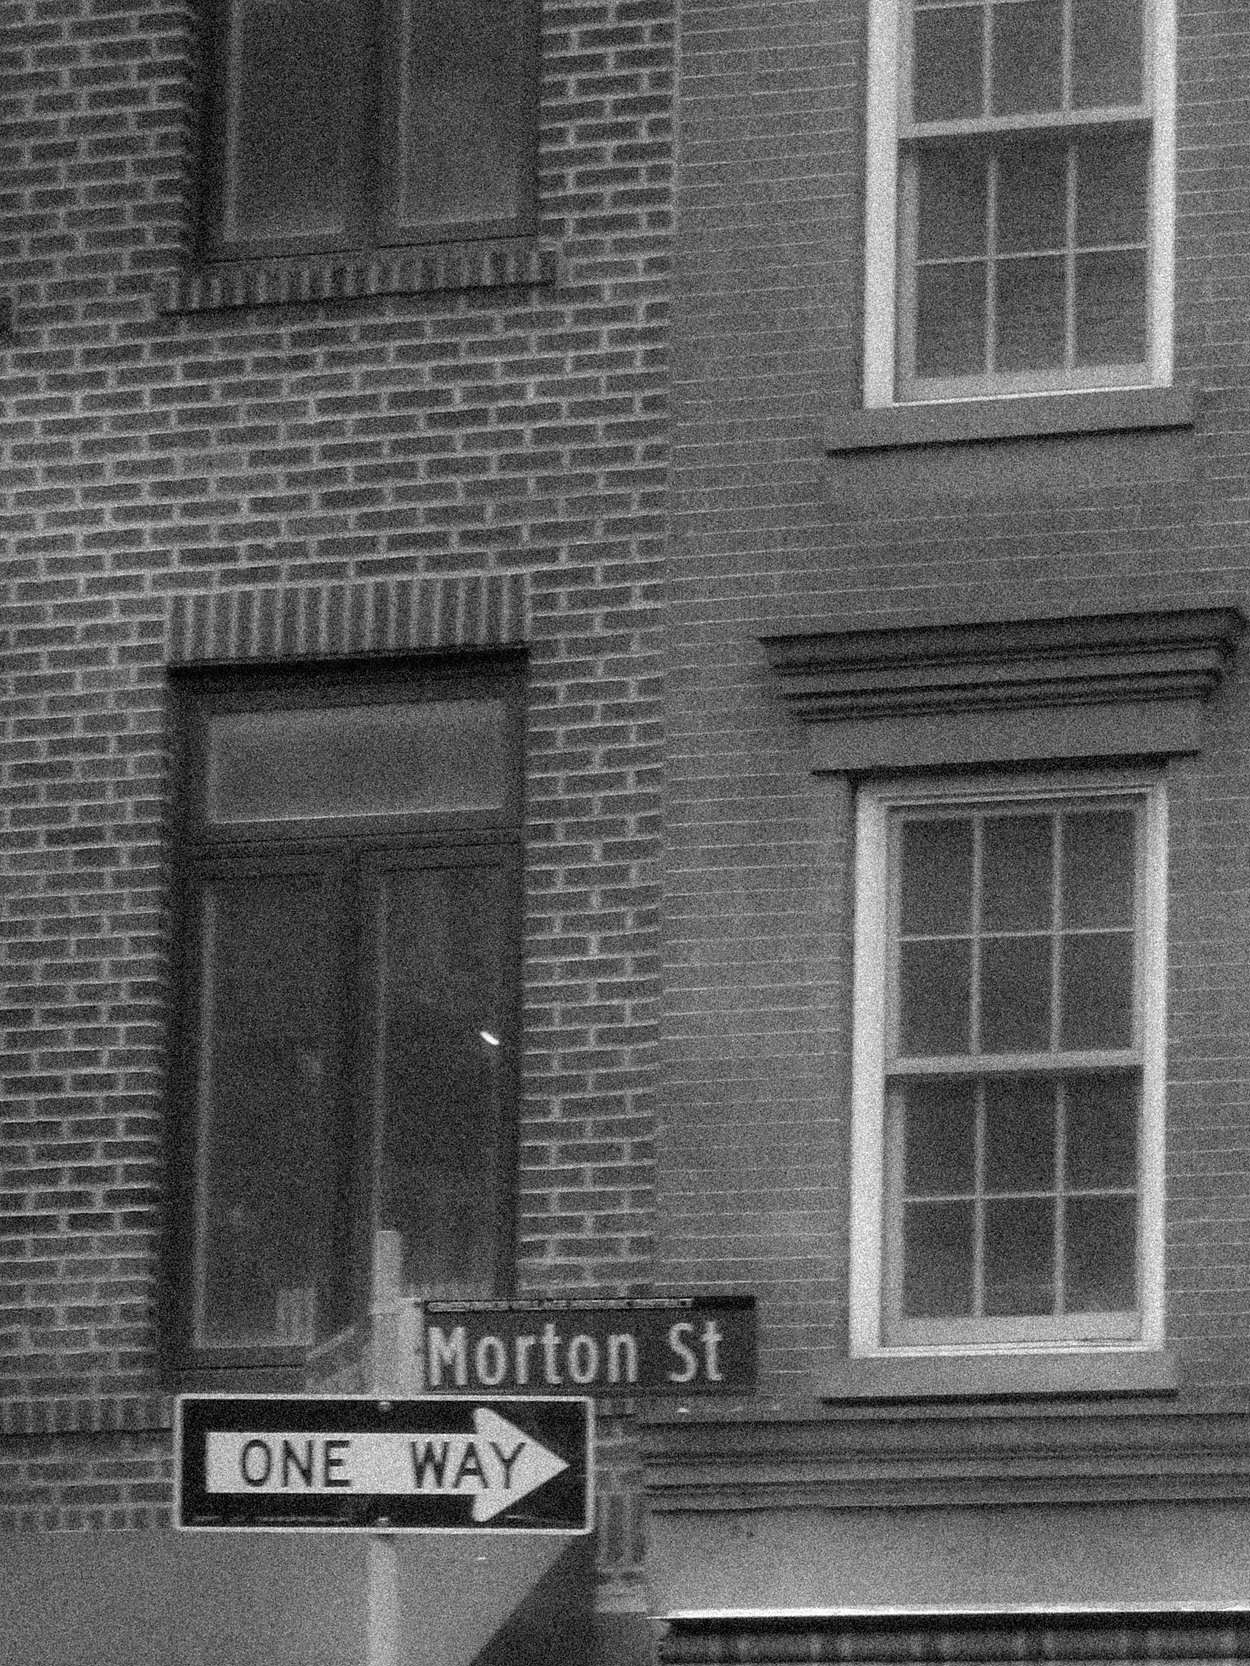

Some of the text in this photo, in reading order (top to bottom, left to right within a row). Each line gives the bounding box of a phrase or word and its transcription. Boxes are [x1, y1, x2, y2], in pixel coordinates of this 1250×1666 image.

[429, 1319, 723, 1387] Morton St
[240, 1438, 527, 1490] ONE WAY
